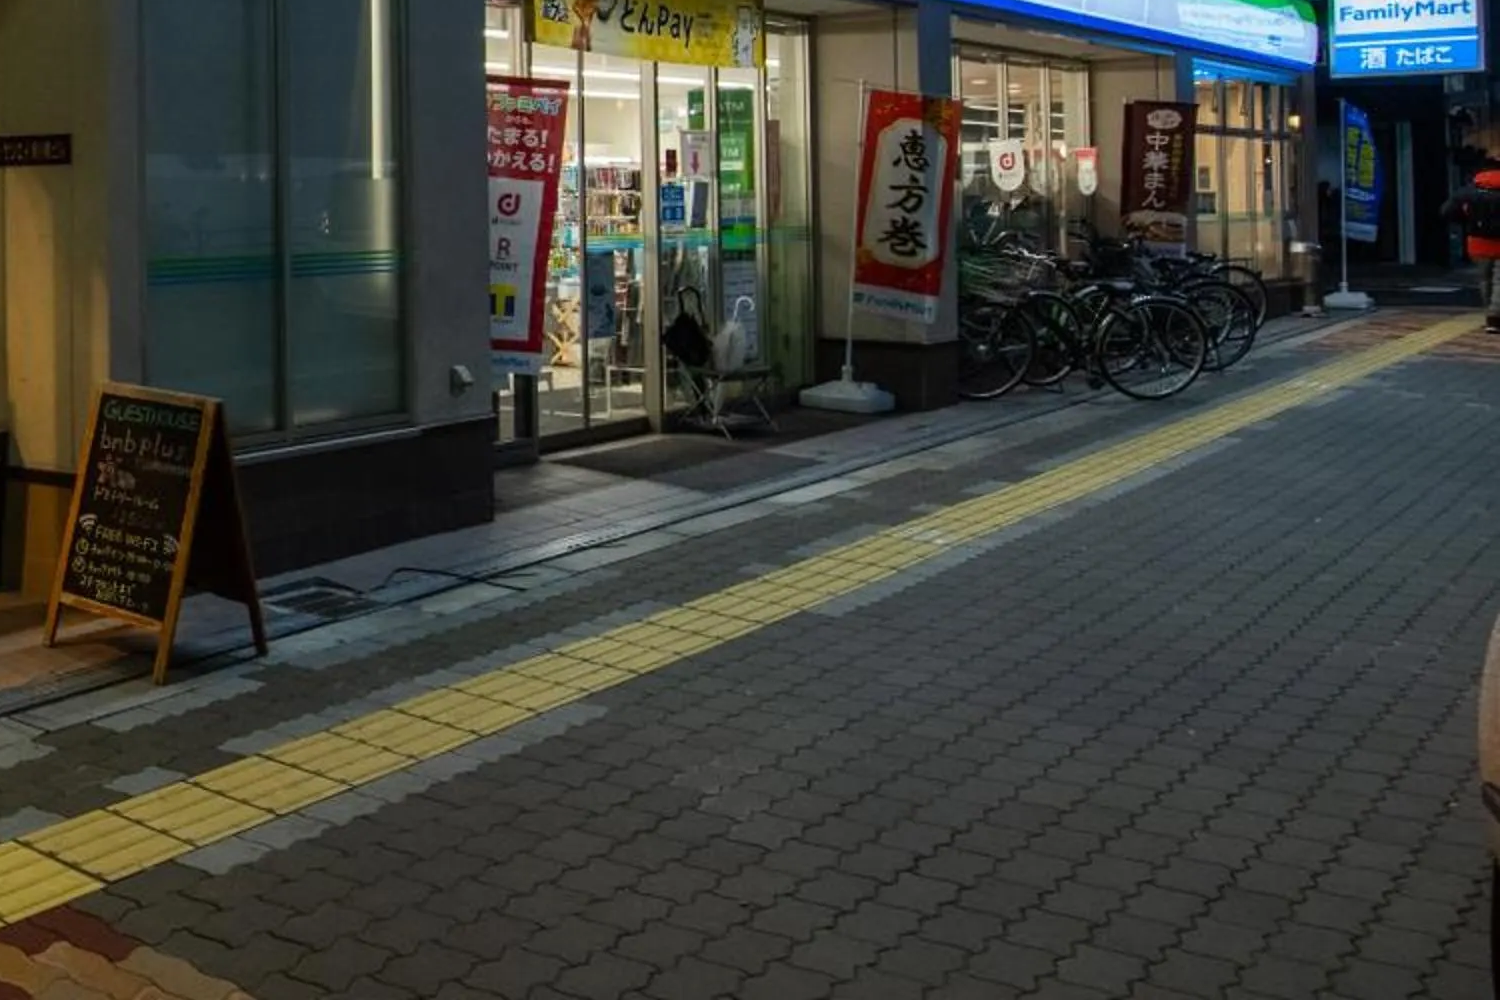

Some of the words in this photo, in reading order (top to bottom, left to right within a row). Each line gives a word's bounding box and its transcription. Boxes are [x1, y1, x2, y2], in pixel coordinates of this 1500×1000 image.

[1338, 0, 1471, 22] FamilyMart
[1360, 47, 1387, 70] 酒
[1396, 45, 1453, 66] たばこ
[487, 149, 555, 174] かえる!
[877, 129, 930, 258] 恵方巻
